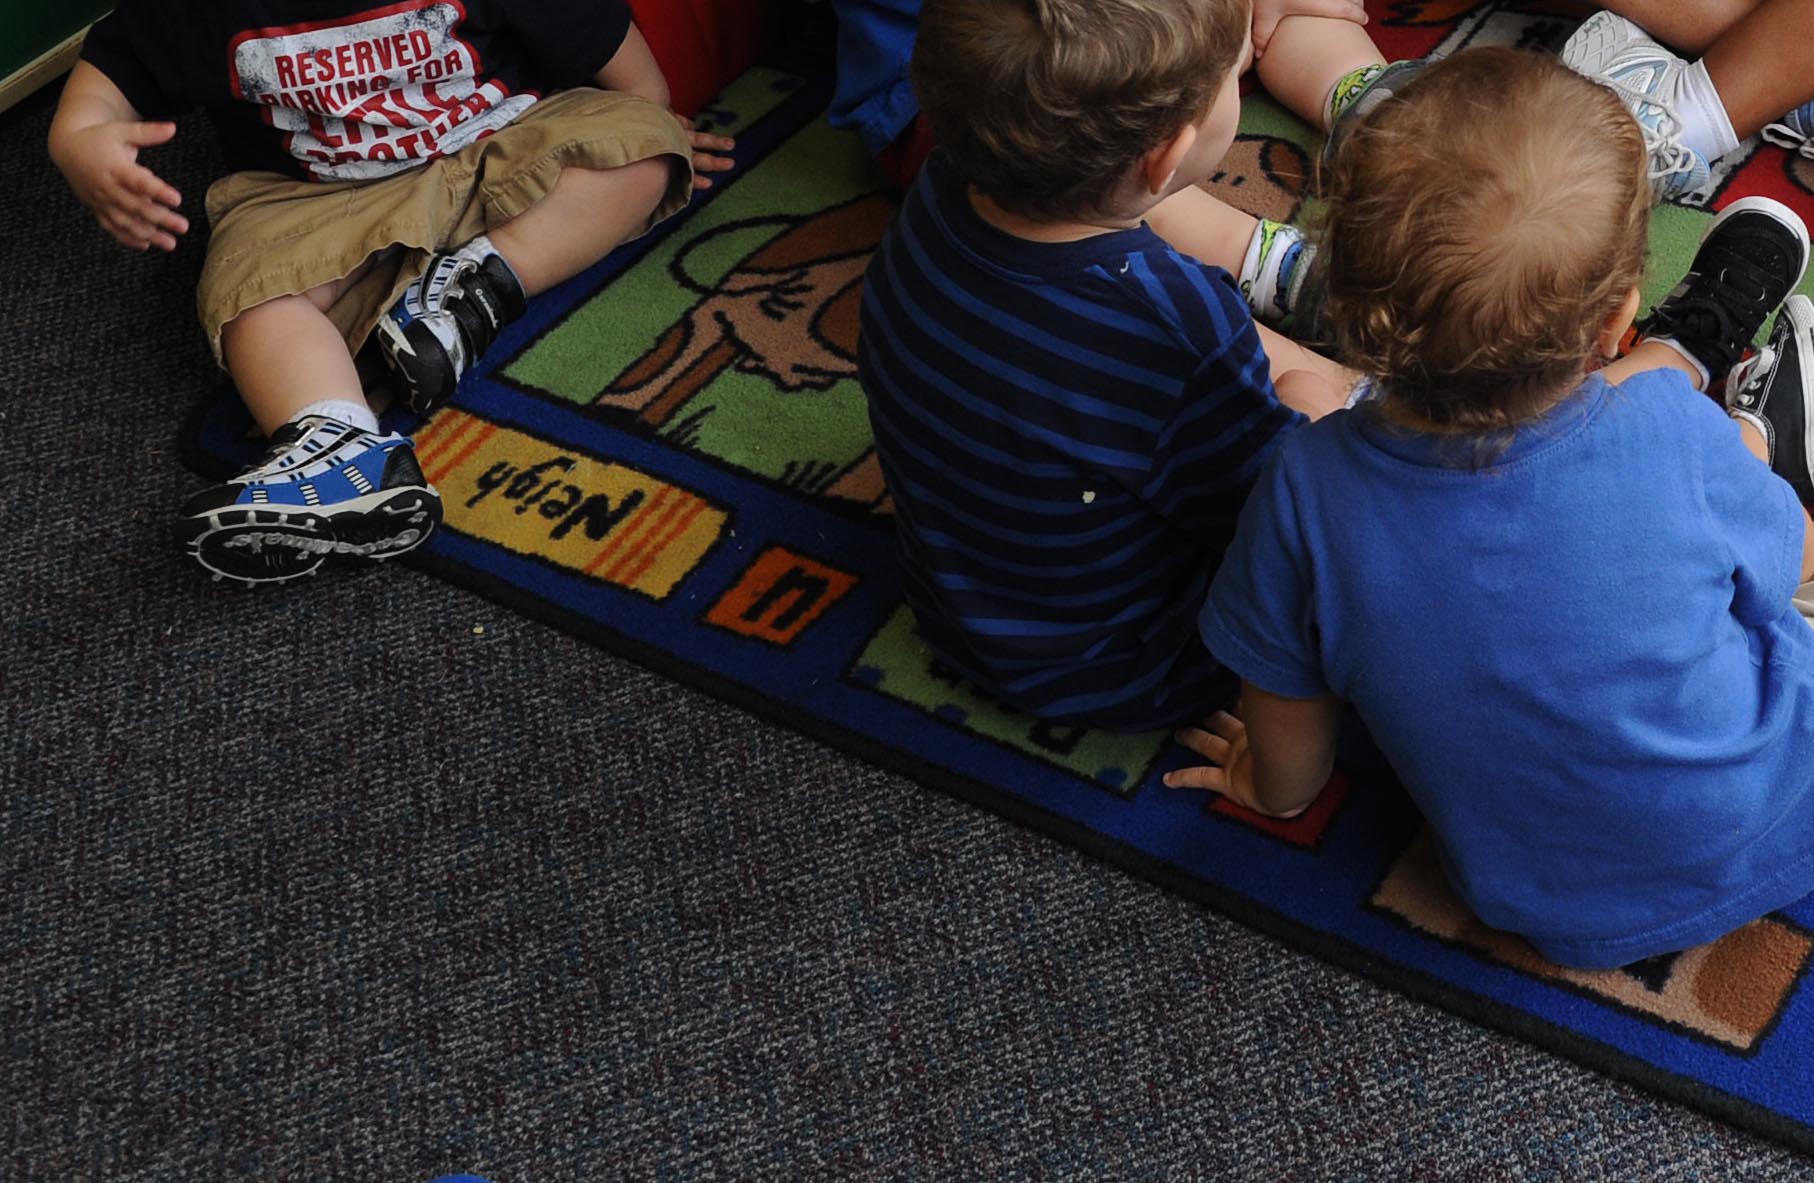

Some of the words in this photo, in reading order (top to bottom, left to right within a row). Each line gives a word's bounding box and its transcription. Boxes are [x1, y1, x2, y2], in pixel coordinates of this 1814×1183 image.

[274, 29, 432, 89] RESERVED
[408, 49, 463, 85] FOR
[466, 456, 646, 541] Neigh
